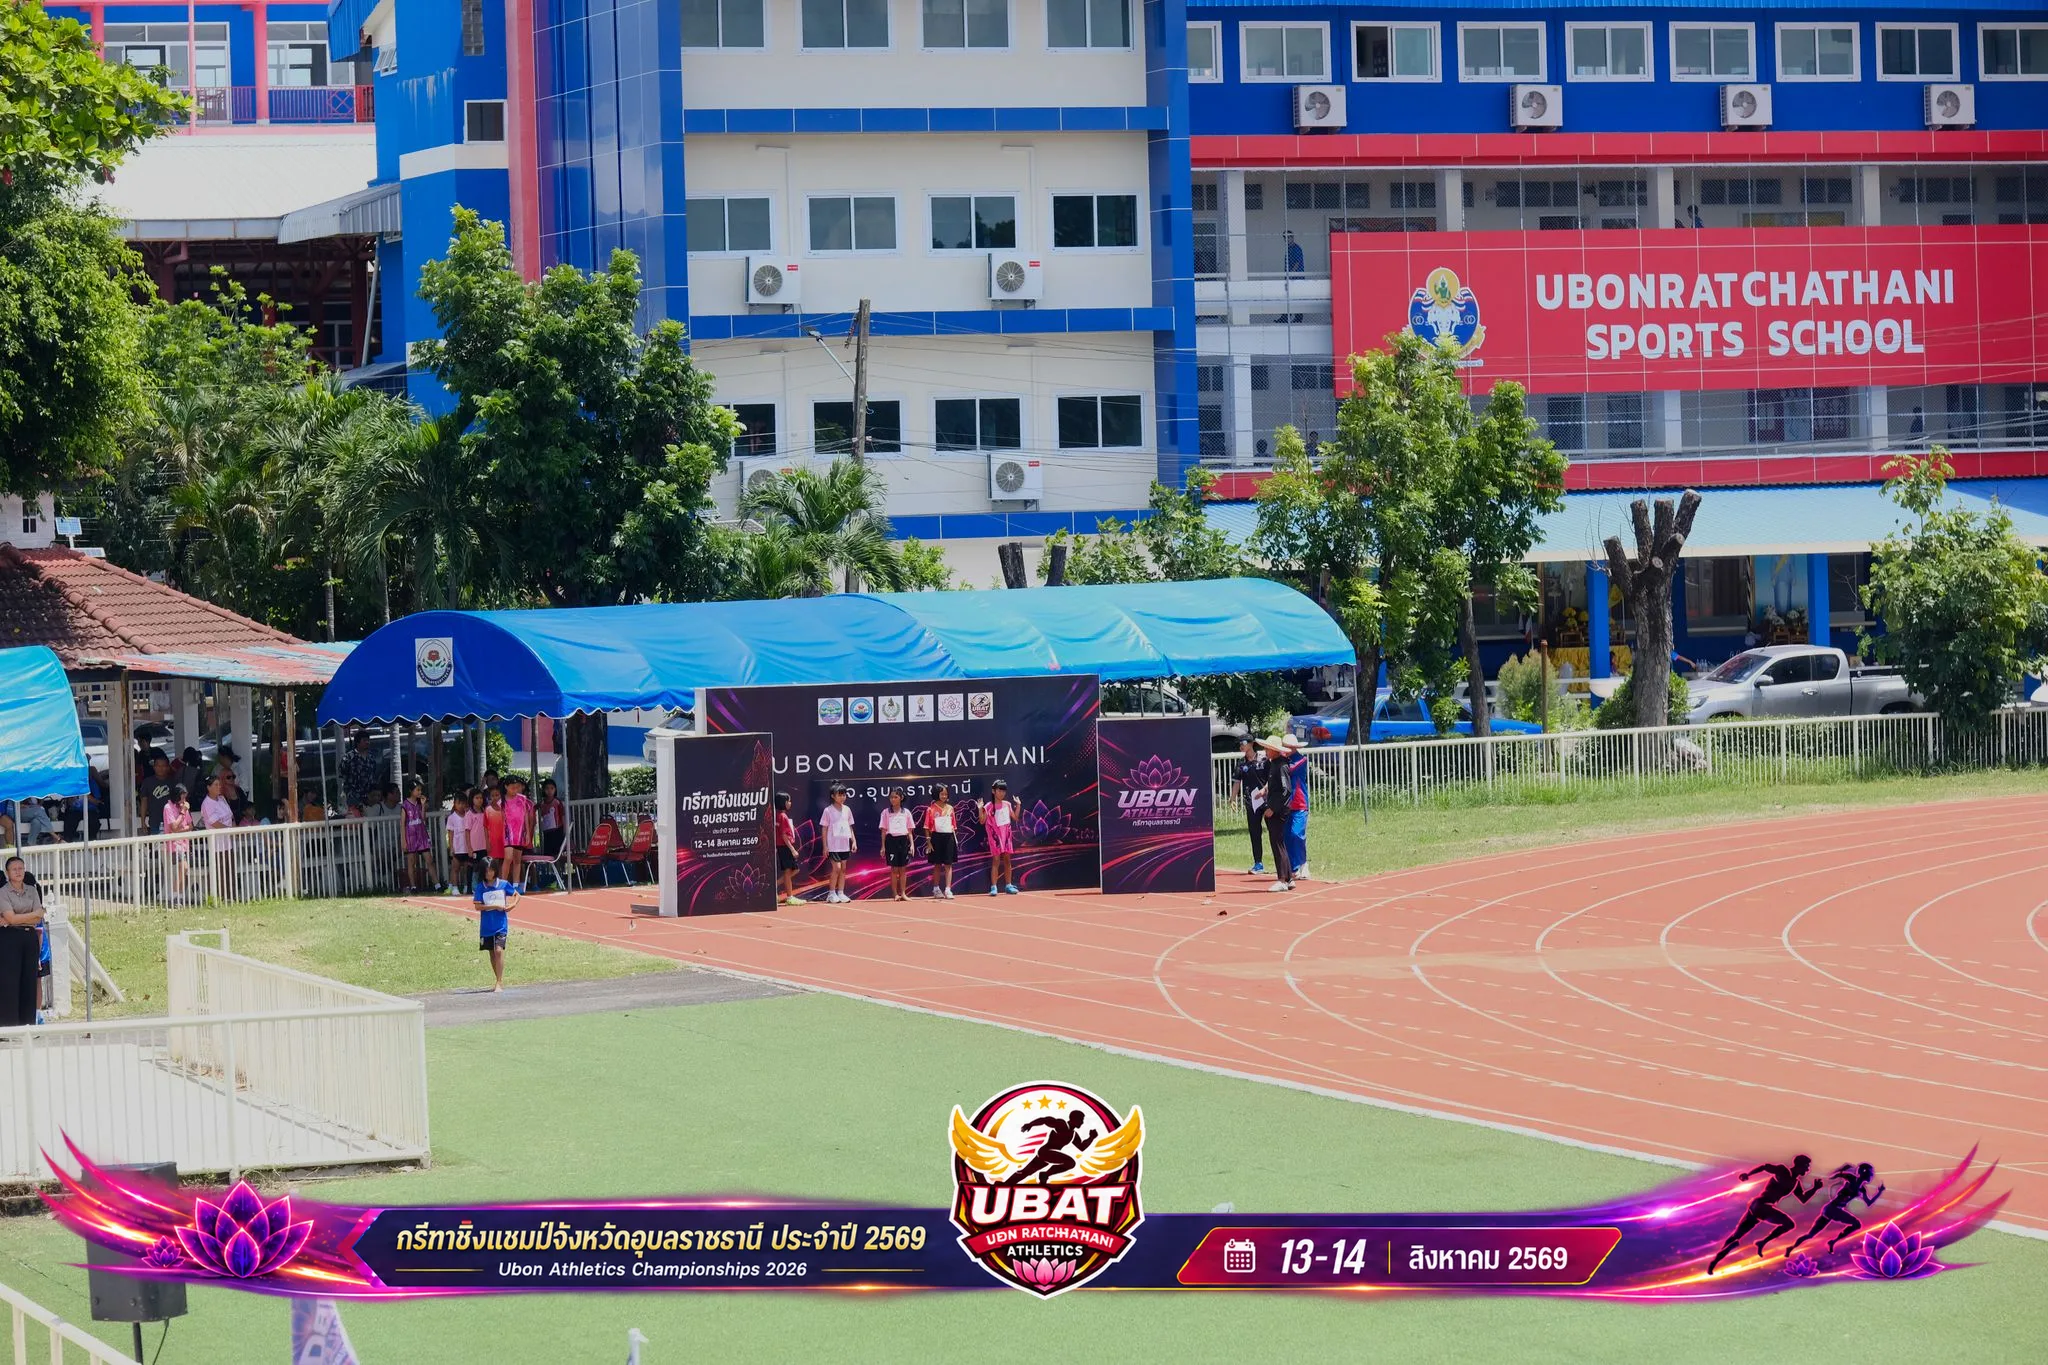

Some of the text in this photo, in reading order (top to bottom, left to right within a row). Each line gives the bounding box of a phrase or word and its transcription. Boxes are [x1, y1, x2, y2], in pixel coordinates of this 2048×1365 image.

[1536, 269, 1955, 310] UBONRATCHATHANI
[1586, 318, 1925, 360] SPORTS SCHOOL
[773, 745, 1044, 774] UBON RATCHATHANI
[1117, 788, 1198, 808] UBON
[693, 807, 757, 828] จ.อุบลราชธานี
[1119, 806, 1195, 819] ATHLETICS
[694, 839, 715, 849] 12-14
[742, 836, 759, 846] 2569
